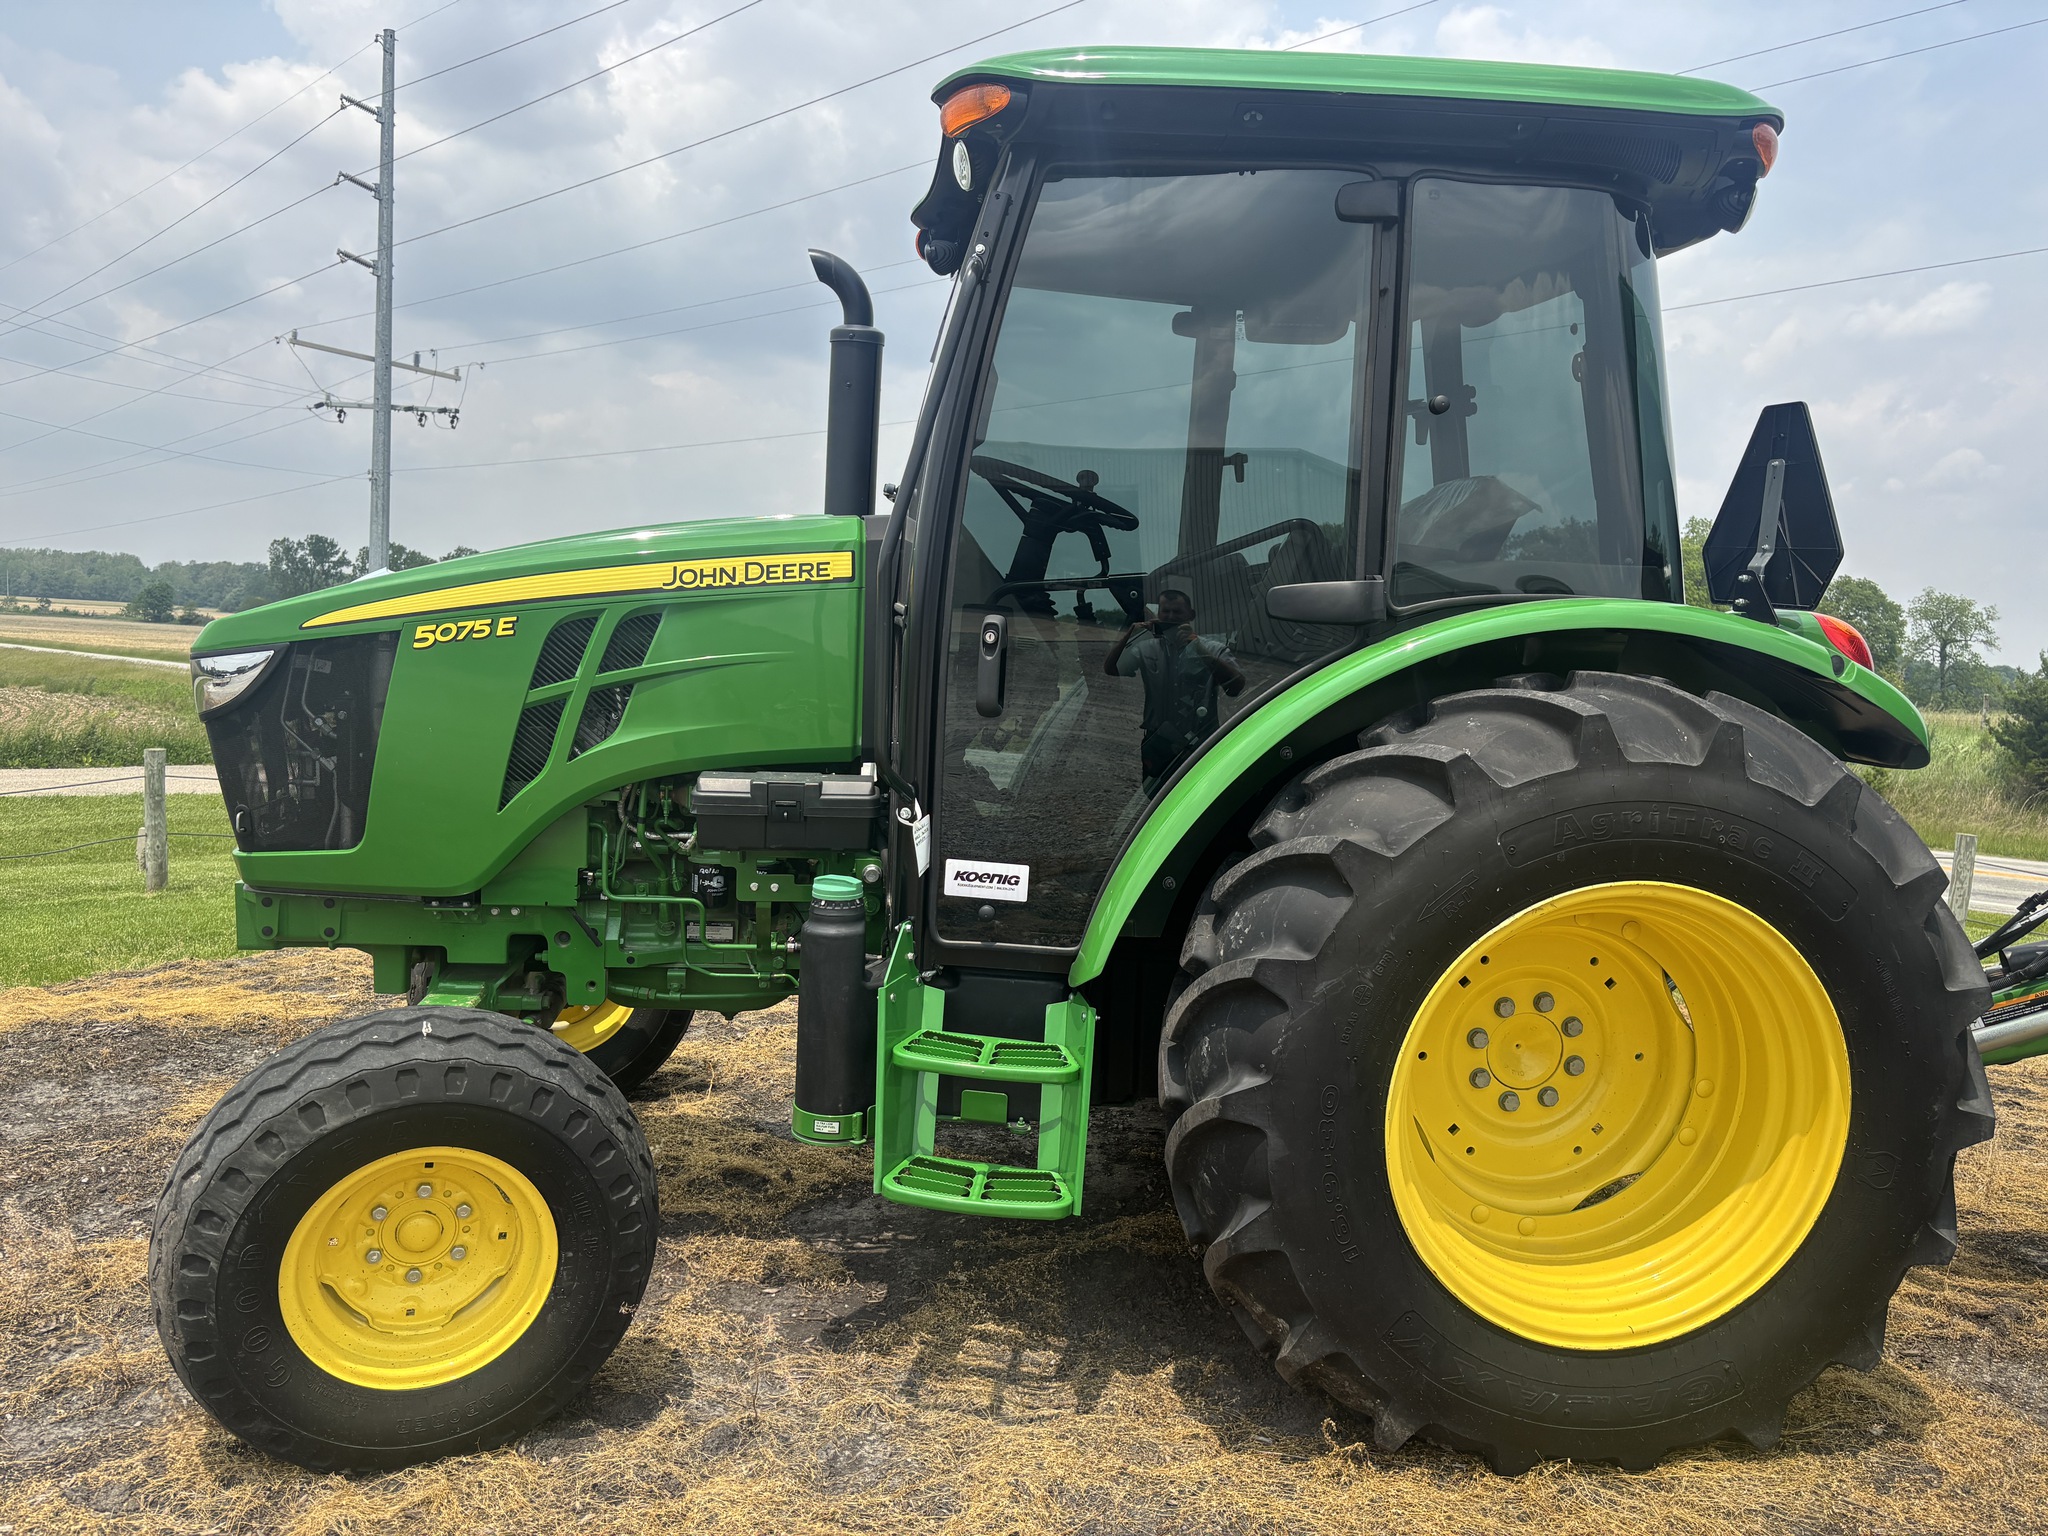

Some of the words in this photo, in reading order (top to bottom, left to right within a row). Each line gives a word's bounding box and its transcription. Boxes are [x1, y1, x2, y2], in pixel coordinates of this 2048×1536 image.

[662, 565, 737, 587] JOHN
[744, 561, 831, 582] DEERE
[412, 618, 493, 650] 5075
[495, 615, 519, 638] E
[1553, 803, 1775, 860] AgriTrac
